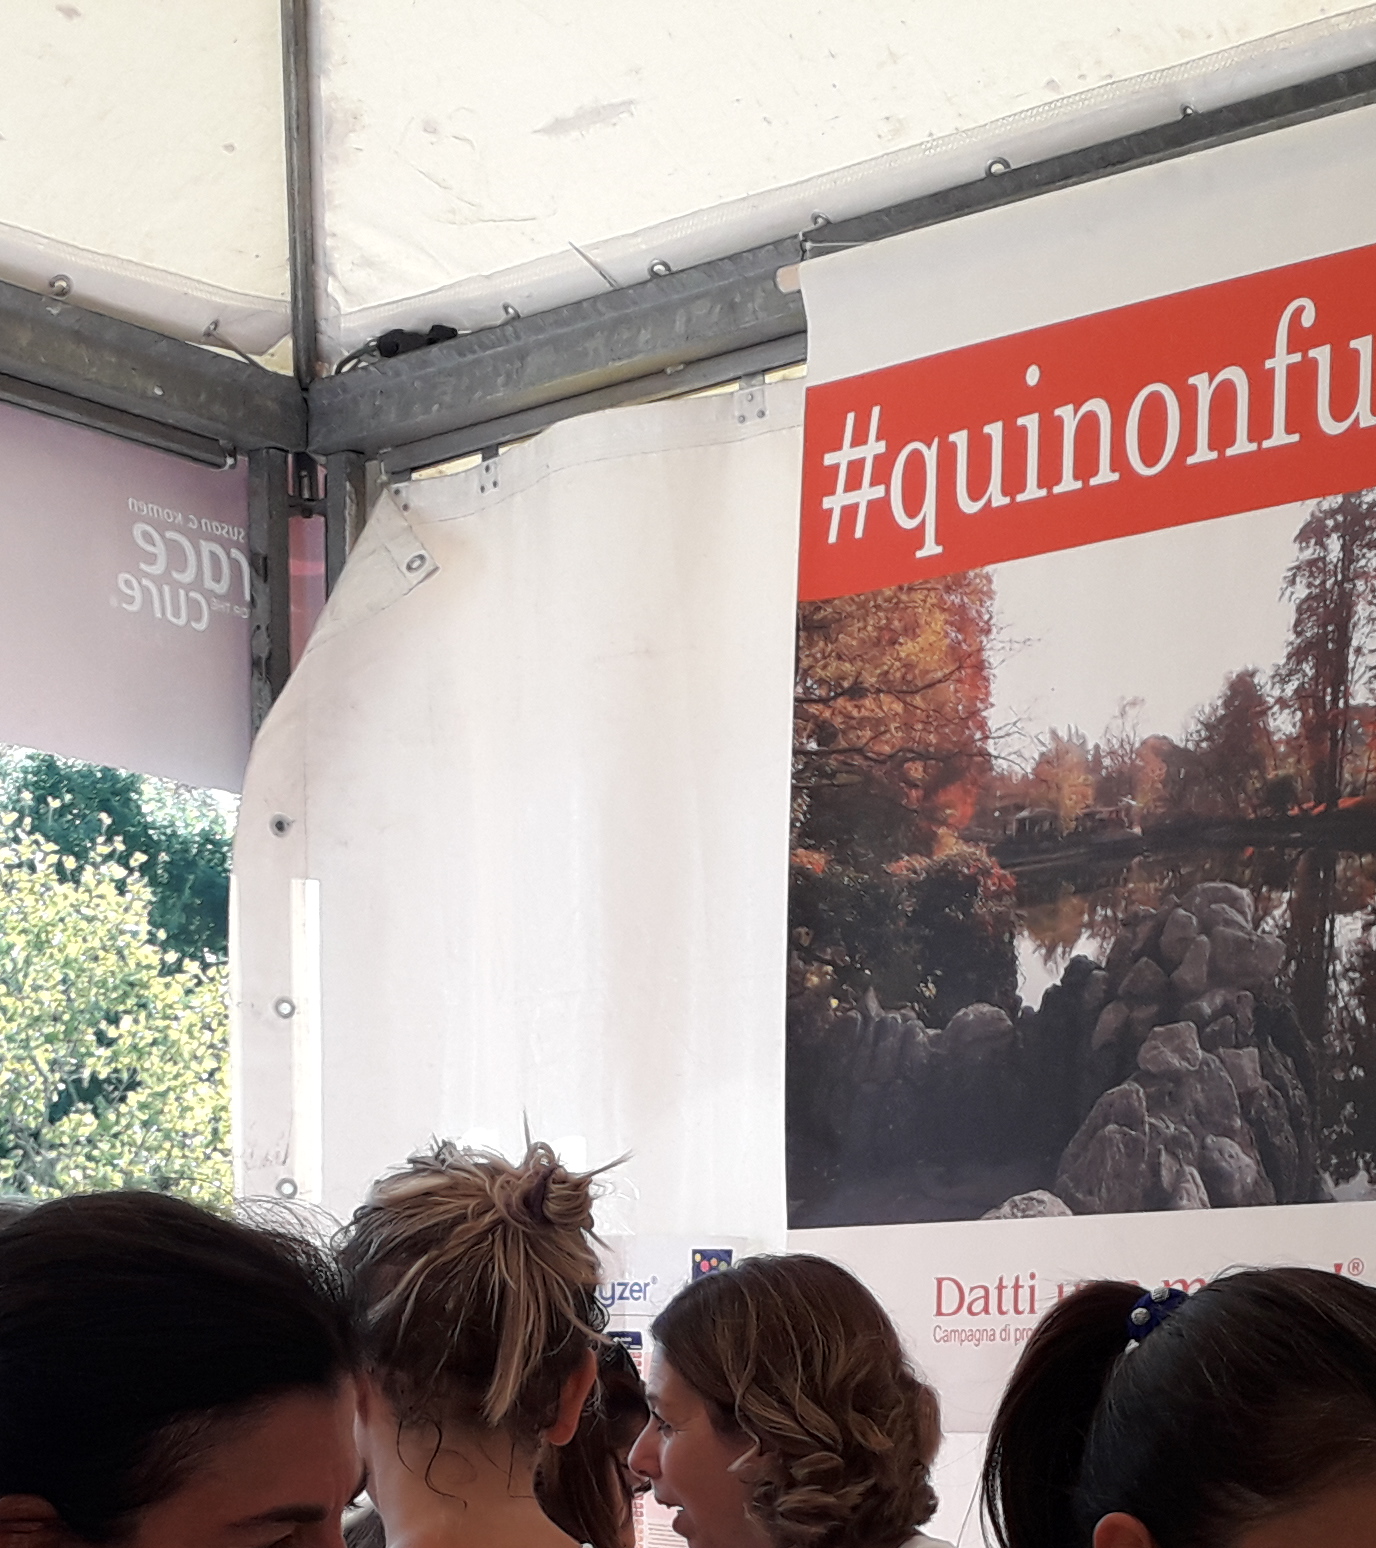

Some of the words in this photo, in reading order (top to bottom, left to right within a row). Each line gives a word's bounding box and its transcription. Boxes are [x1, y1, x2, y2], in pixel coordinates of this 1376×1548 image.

[933, 1271, 1039, 1318] Datti
[933, 1324, 996, 1347] Campagna
[999, 1323, 1012, 1344] di
